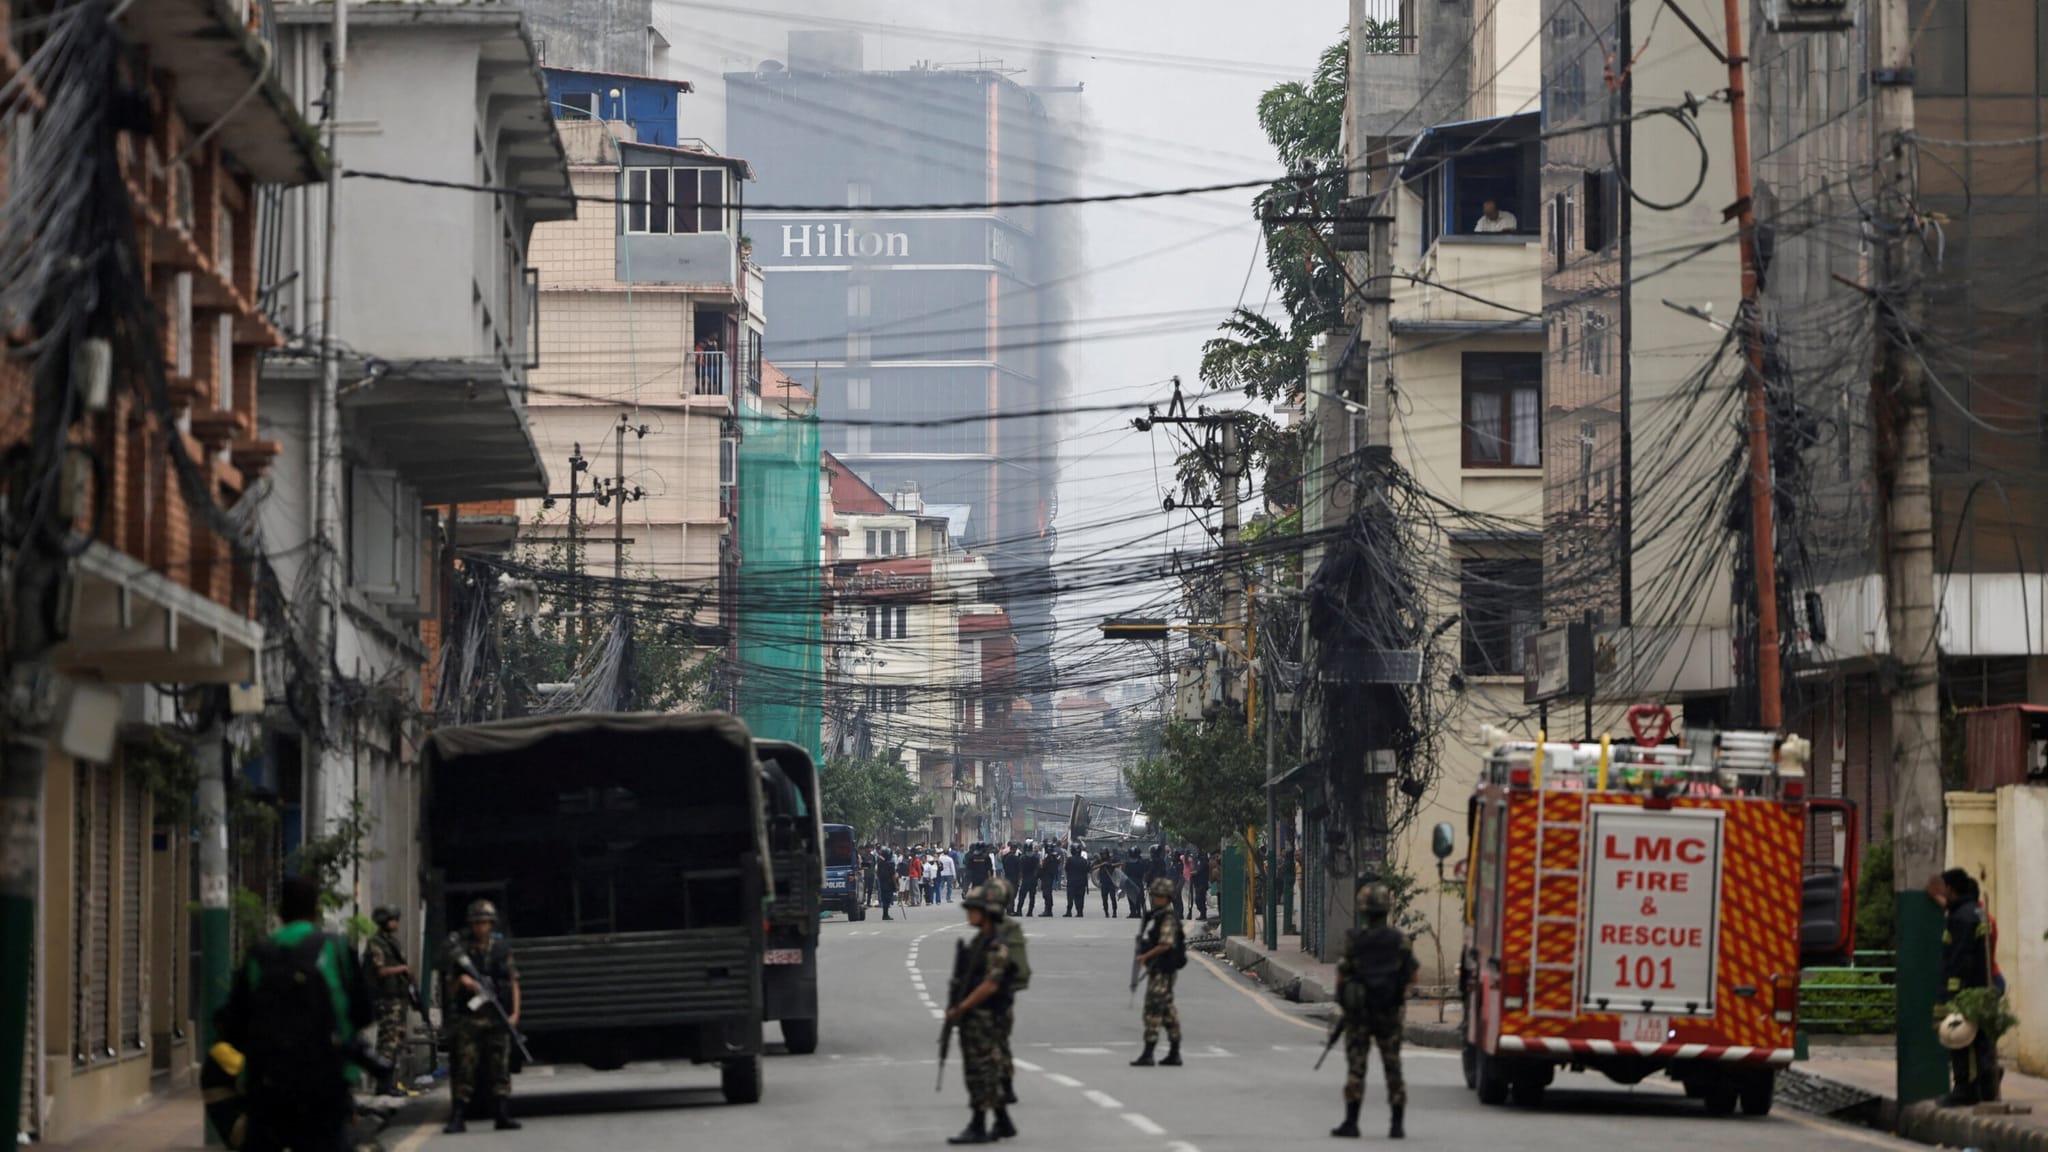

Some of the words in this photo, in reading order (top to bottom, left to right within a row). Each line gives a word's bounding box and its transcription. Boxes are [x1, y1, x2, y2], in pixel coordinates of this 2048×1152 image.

[781, 223, 910, 257] Hilton
[1605, 835, 1706, 864] LMC
[1616, 870, 1688, 892] FIRE
[1640, 896, 1657, 916] &
[1600, 924, 1702, 947] RESCUE
[1615, 954, 1676, 990] 101
